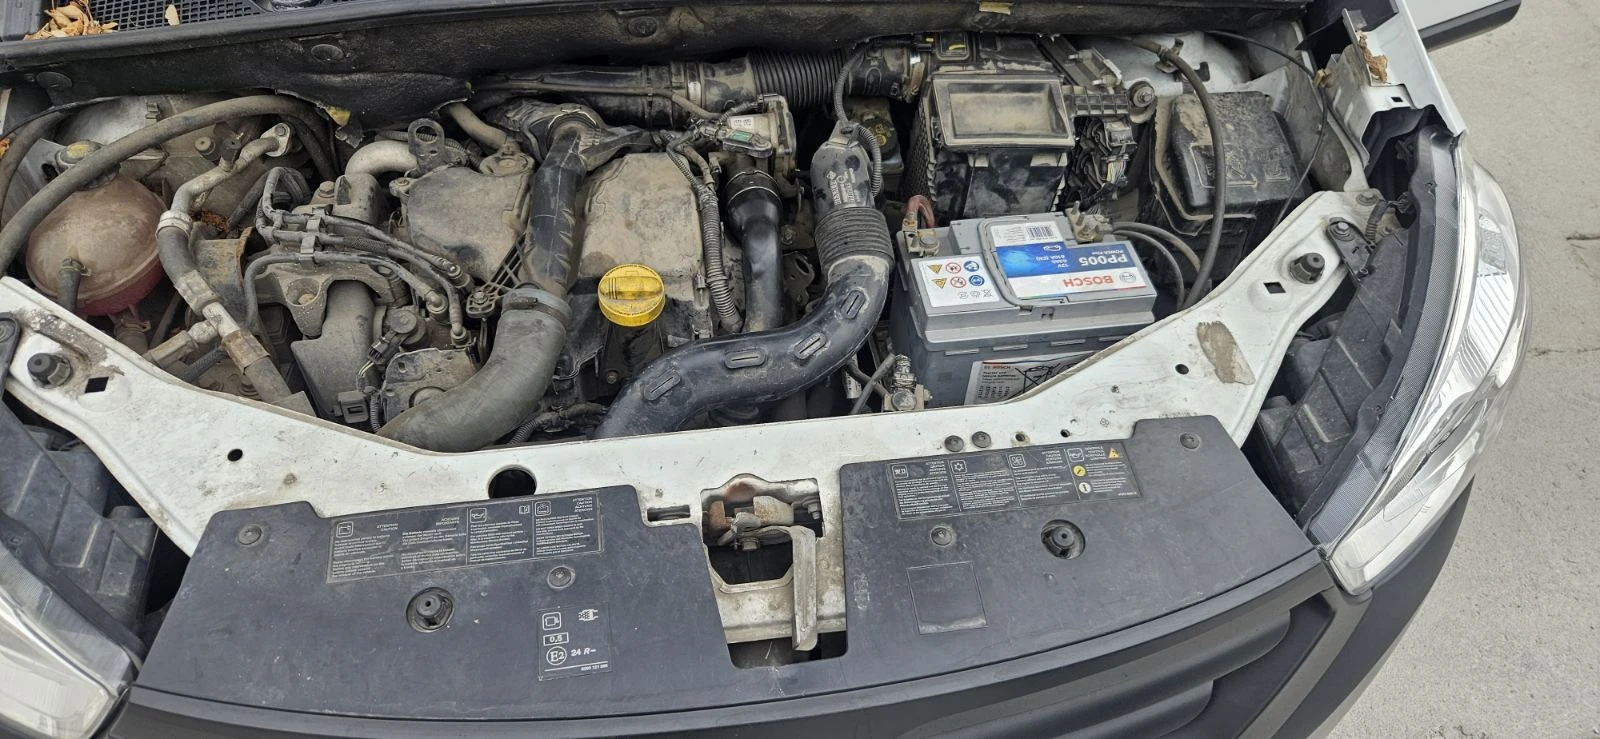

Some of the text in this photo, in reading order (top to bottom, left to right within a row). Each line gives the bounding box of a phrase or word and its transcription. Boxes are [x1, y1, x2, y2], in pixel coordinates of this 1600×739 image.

[1078, 254, 1128, 266] PP005
[1063, 276, 1114, 288] BOSCH
[550, 650, 565, 662] E2
